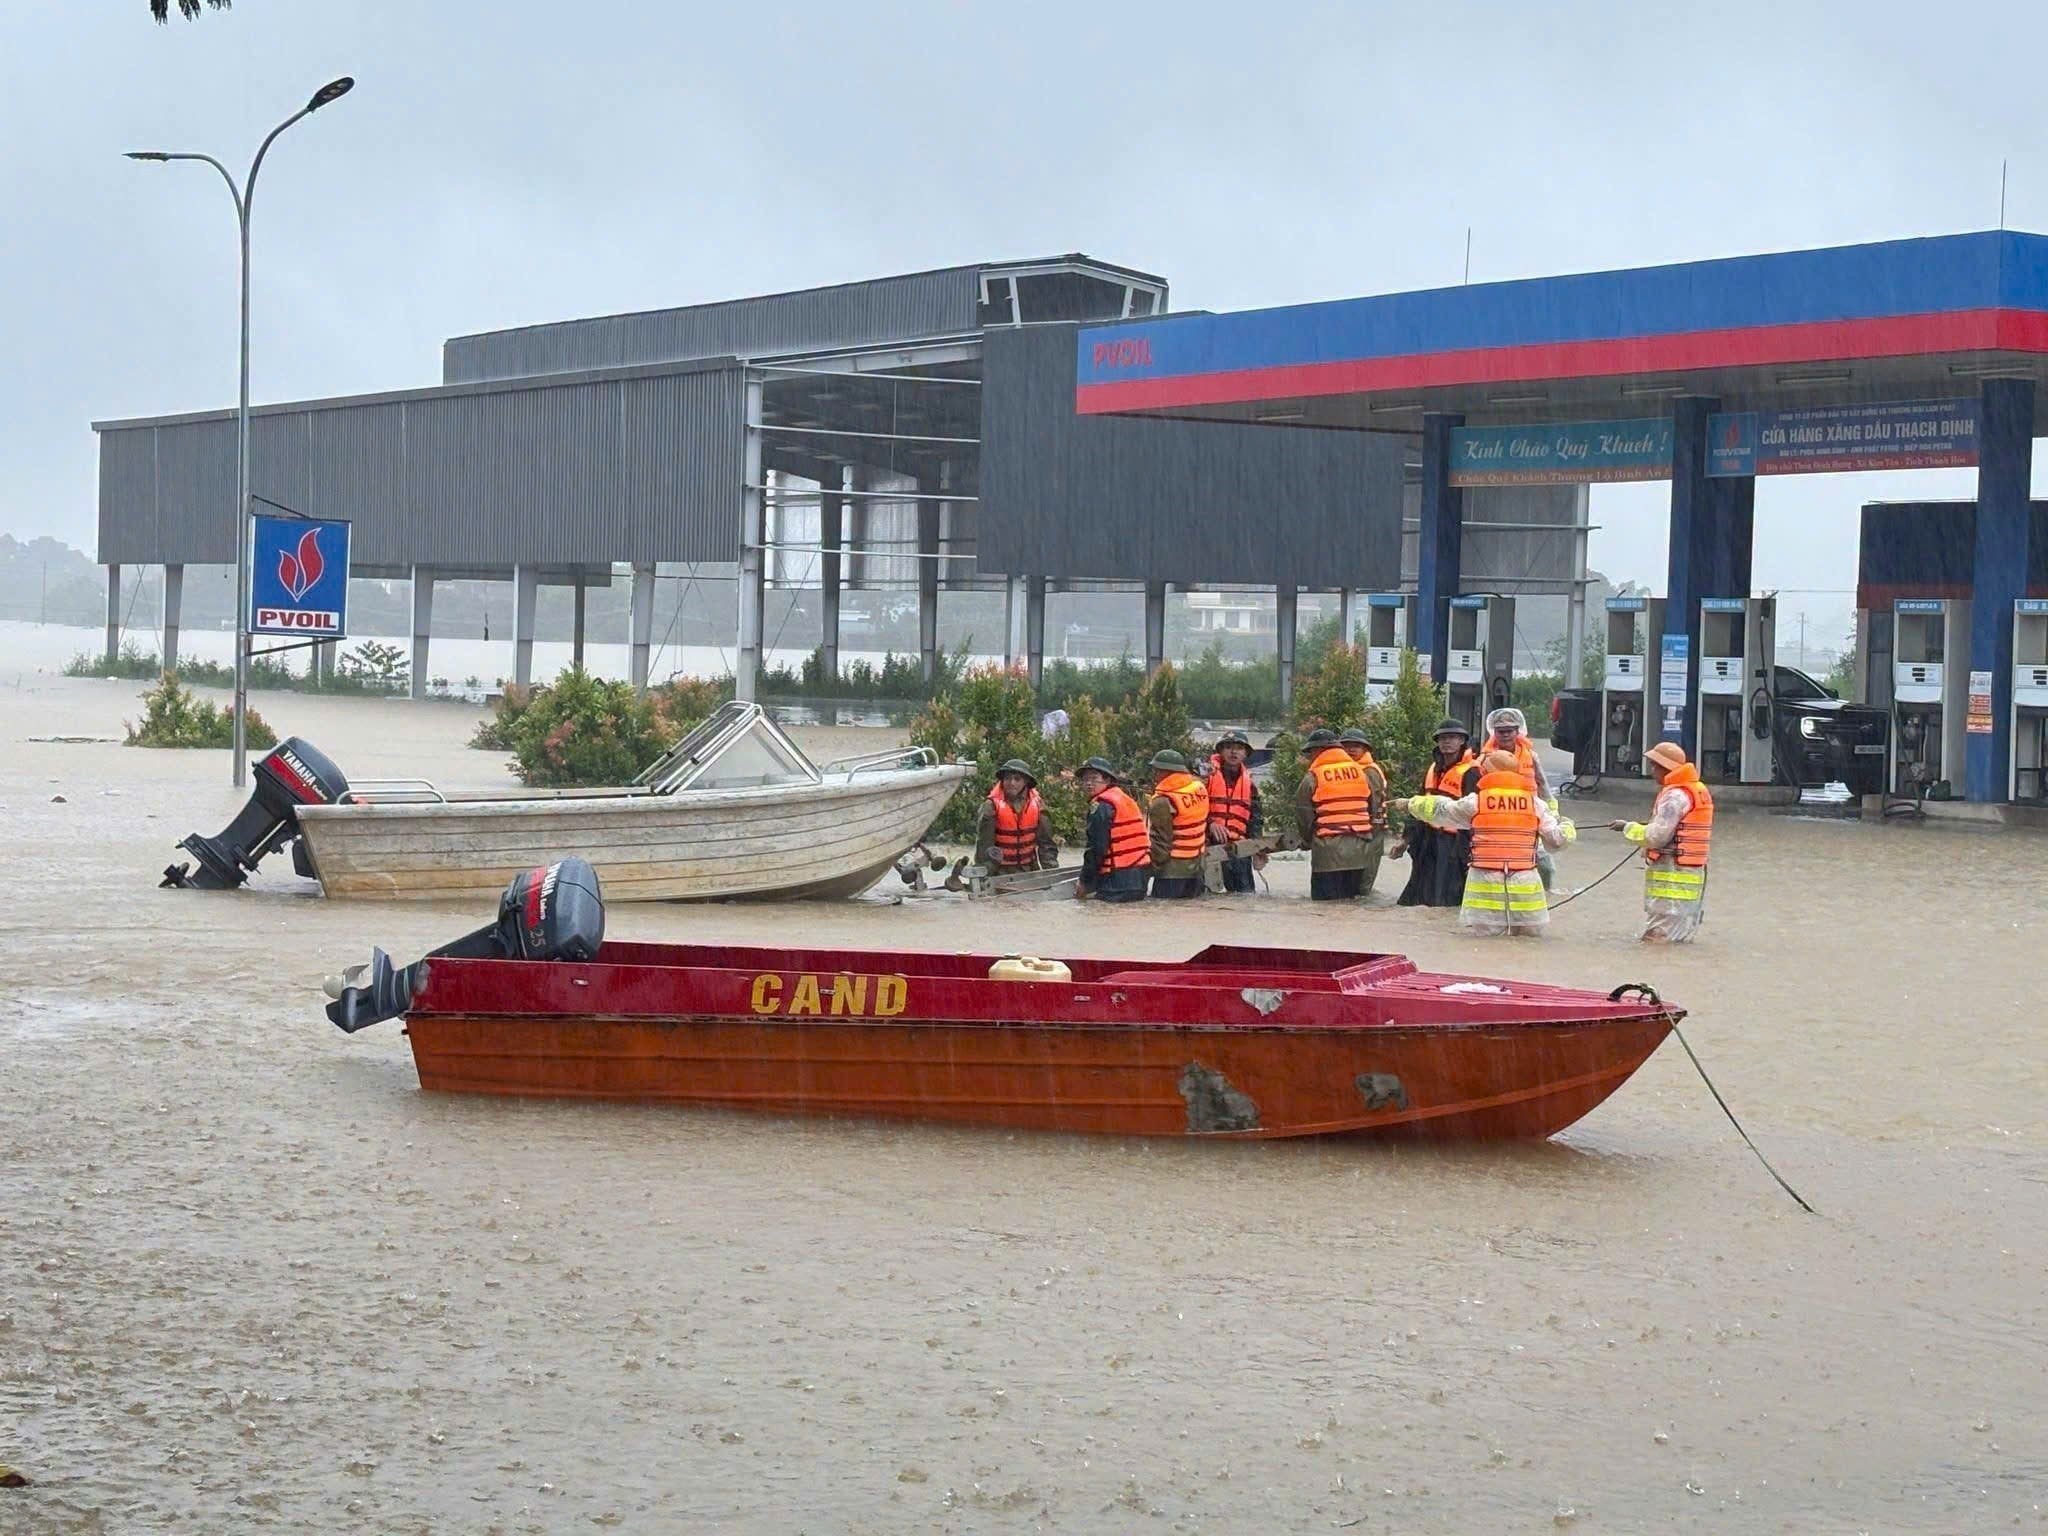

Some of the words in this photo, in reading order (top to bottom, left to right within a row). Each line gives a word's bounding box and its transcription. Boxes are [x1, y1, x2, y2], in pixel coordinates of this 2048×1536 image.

[1093, 338, 1152, 368] PVOIL
[1762, 424, 1786, 445] CỬA
[1790, 424, 1823, 444] HÀNG
[1827, 422, 1861, 441] XĂNG
[1865, 419, 1890, 440] DẦU
[1895, 421, 1937, 442] THẠCH
[1941, 419, 1975, 439] ĐỊNH
[259, 610, 337, 629] PVOIL
[283, 750, 317, 786] YAMAHA
[1324, 766, 1360, 782] CAND
[1486, 796, 1528, 811] CAND
[751, 973, 908, 1016] CAND
